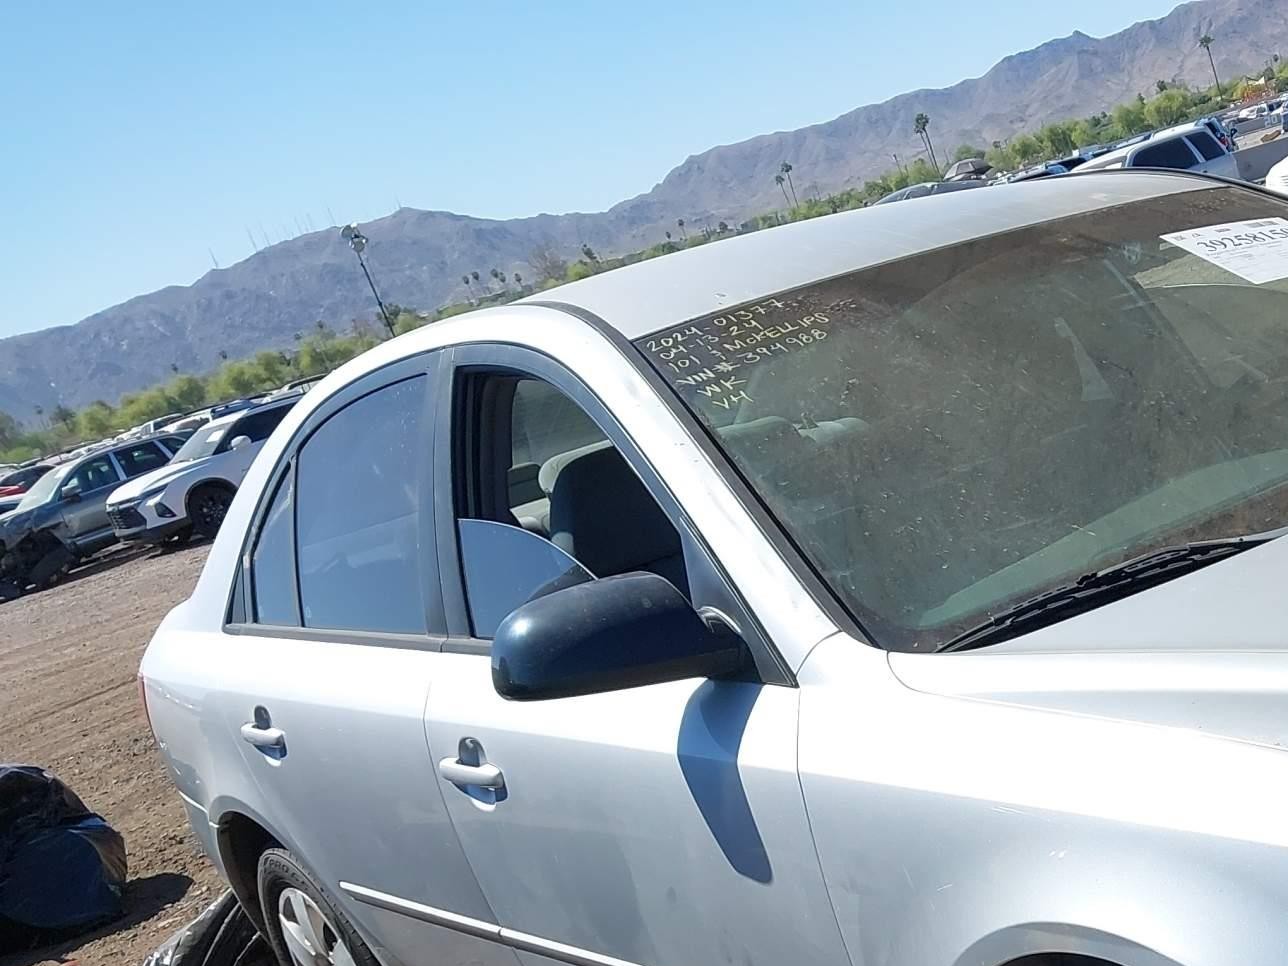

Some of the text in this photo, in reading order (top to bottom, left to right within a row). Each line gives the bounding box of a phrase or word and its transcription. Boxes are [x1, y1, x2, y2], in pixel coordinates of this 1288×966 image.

[646, 298, 785, 352] 2024-01377
[659, 319, 764, 360] 04-13-24
[668, 354, 701, 373] 101
[736, 328, 828, 364] 394988
